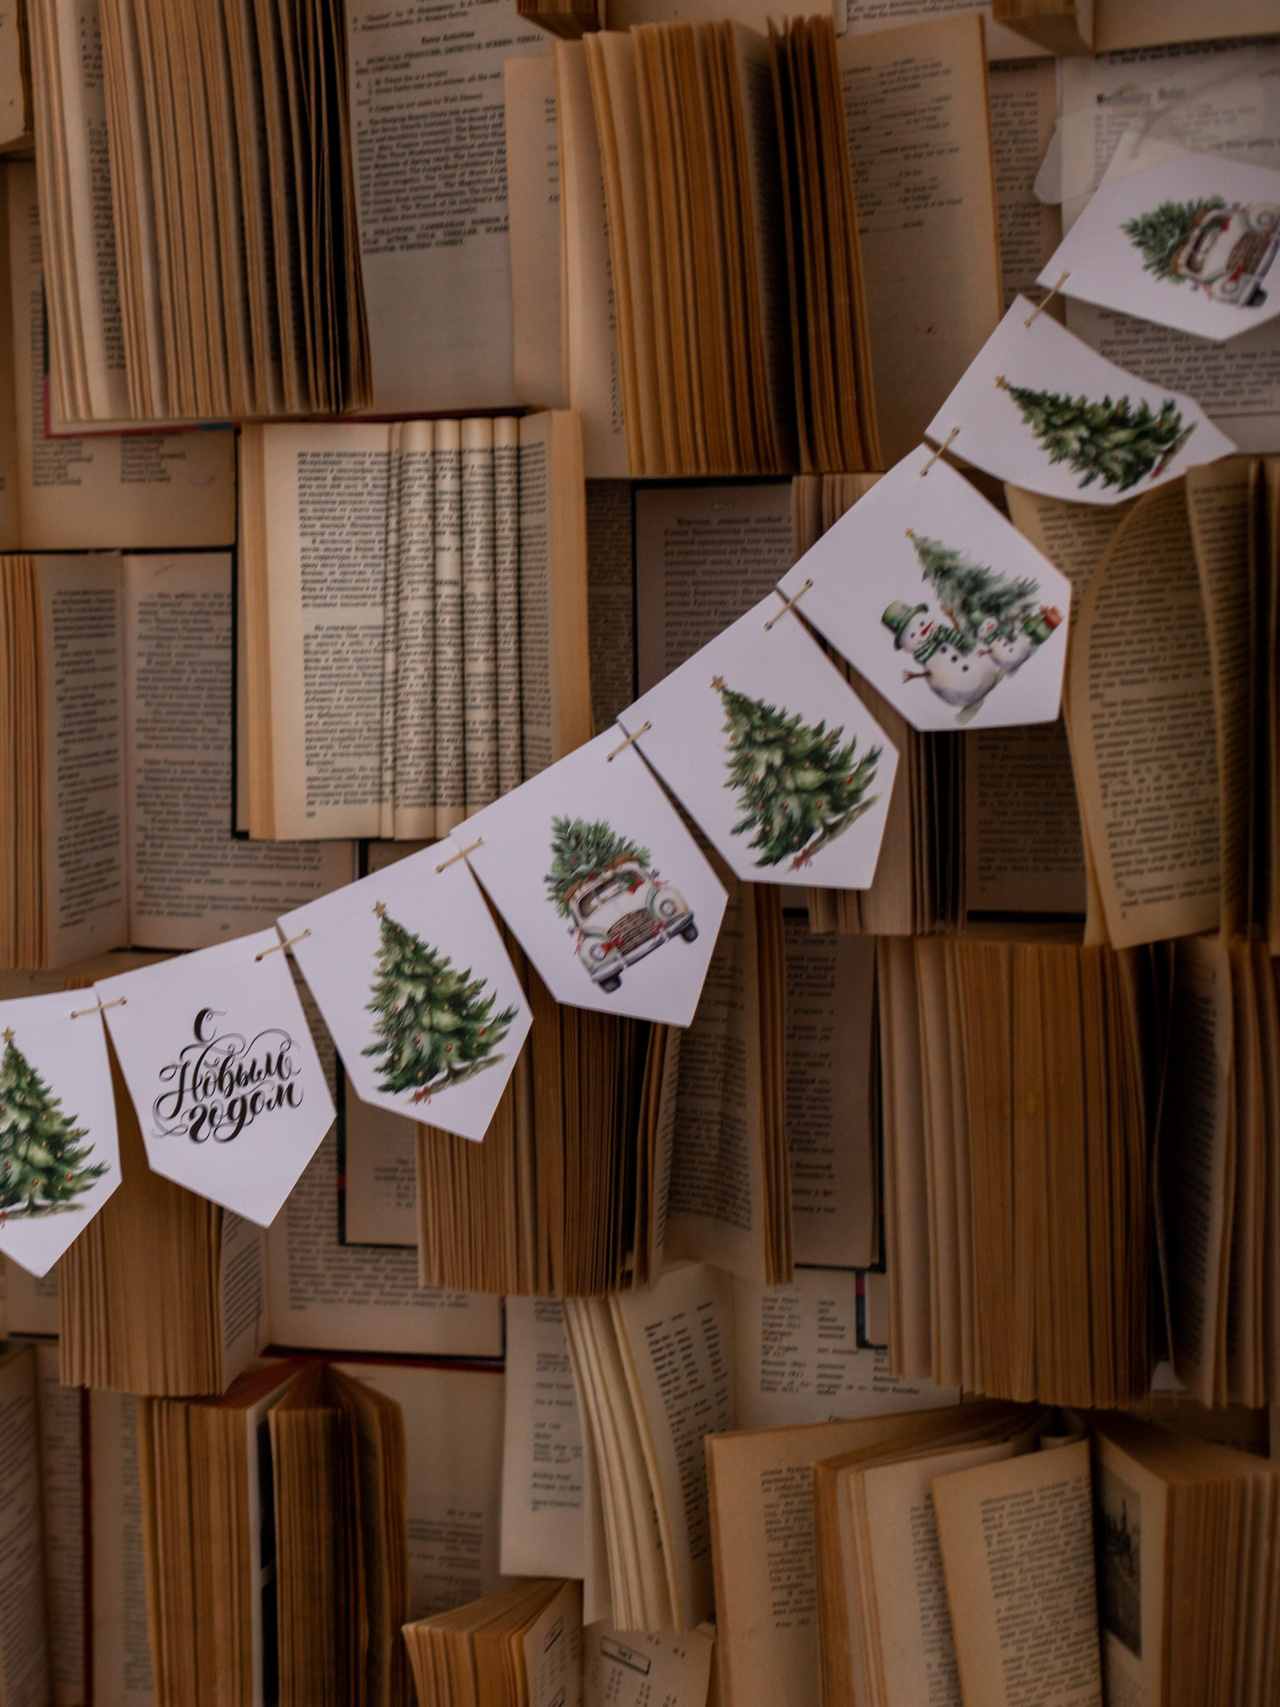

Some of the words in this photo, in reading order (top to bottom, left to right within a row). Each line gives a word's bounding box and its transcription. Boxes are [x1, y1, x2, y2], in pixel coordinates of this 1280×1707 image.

[193, 1006, 227, 1044] С
[157, 1028, 303, 1121] Новым
[170, 1082, 305, 1144] годом
